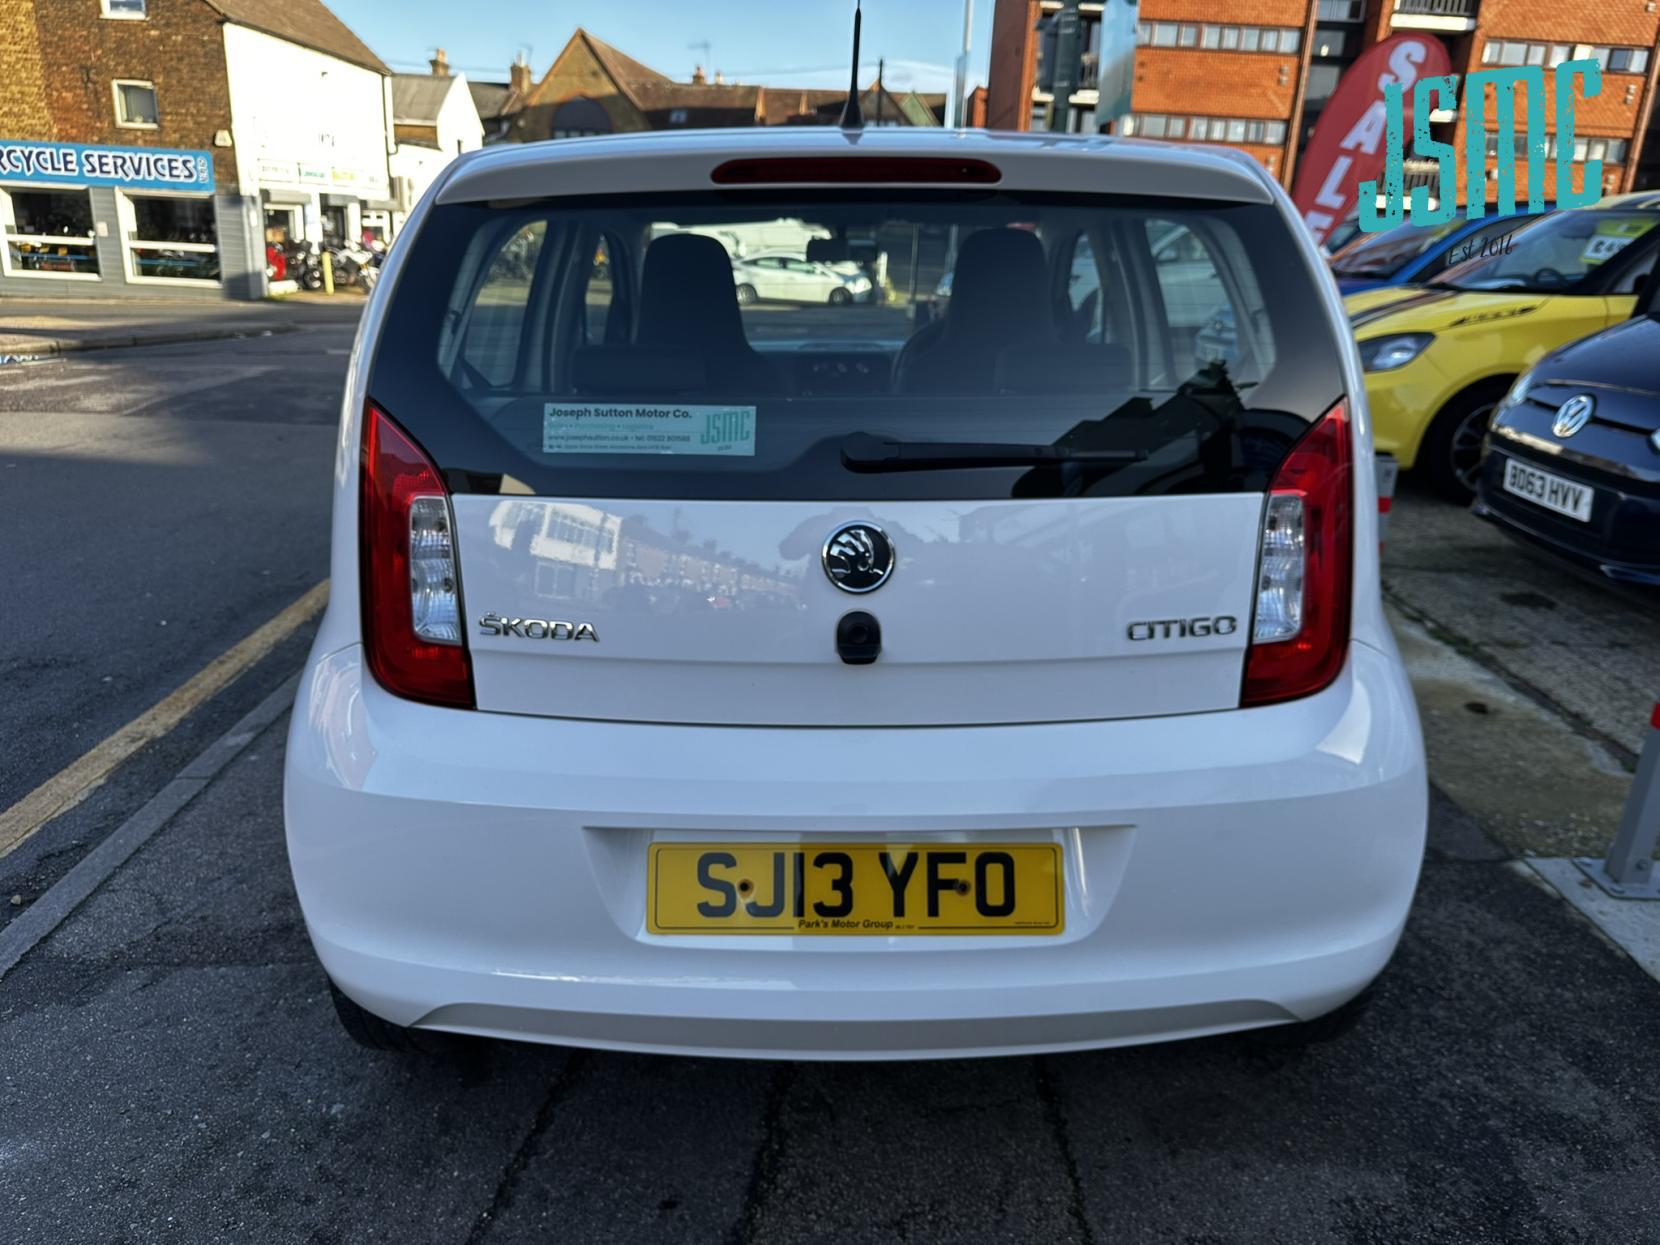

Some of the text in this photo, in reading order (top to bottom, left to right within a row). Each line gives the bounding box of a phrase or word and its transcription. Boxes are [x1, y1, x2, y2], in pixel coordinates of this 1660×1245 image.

[83, 152, 197, 180] SERVICES
[549, 407, 693, 420] Joseph Sutton Motor Co.
[700, 410, 752, 445] JSMC
[479, 611, 600, 643] ŠKODA
[1127, 615, 1238, 641] CITIGO
[696, 851, 1016, 918] SJ13 YFO
[798, 919, 830, 929] Park's
[831, 919, 861, 929] Motor
[862, 919, 894, 931] Group
